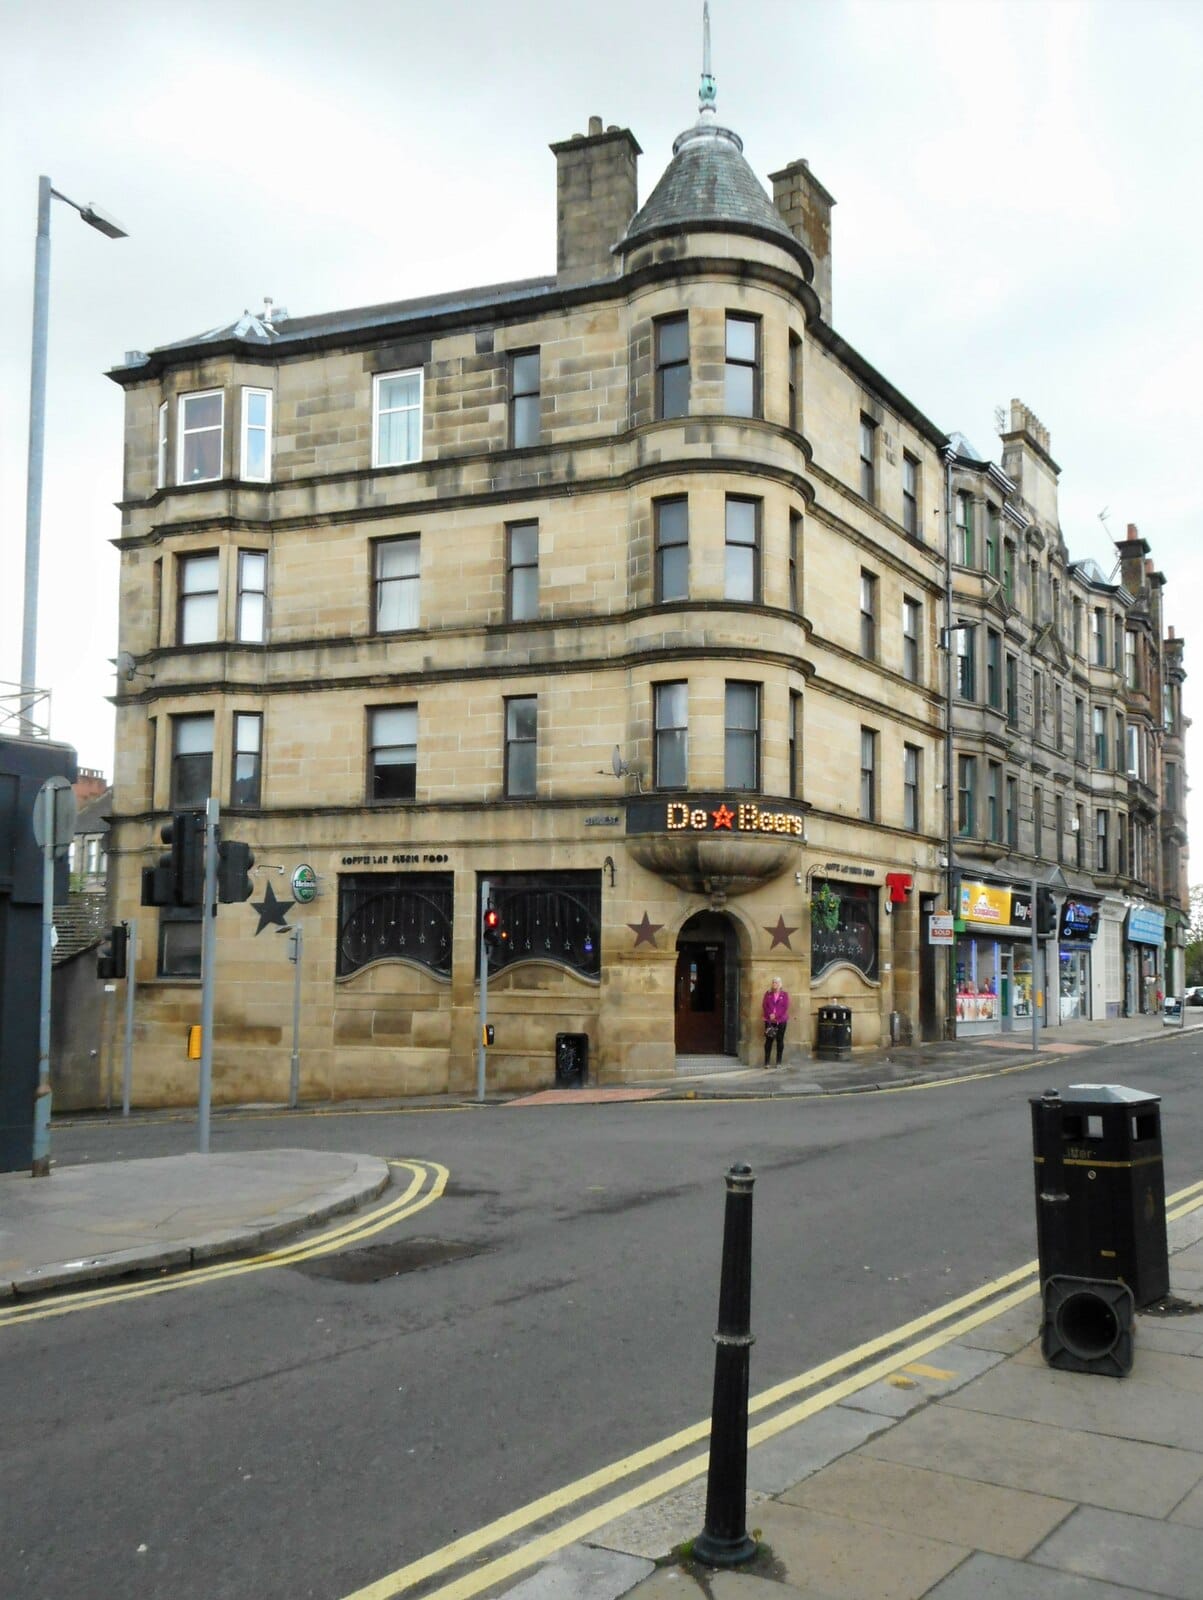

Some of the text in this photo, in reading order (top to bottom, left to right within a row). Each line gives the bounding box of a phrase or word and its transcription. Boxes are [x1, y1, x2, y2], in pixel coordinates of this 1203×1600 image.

[666, 802, 803, 835] De Beers
[373, 855, 388, 864] BAR
[392, 854, 419, 863] MUSIC
[423, 854, 448, 863] FOOD
